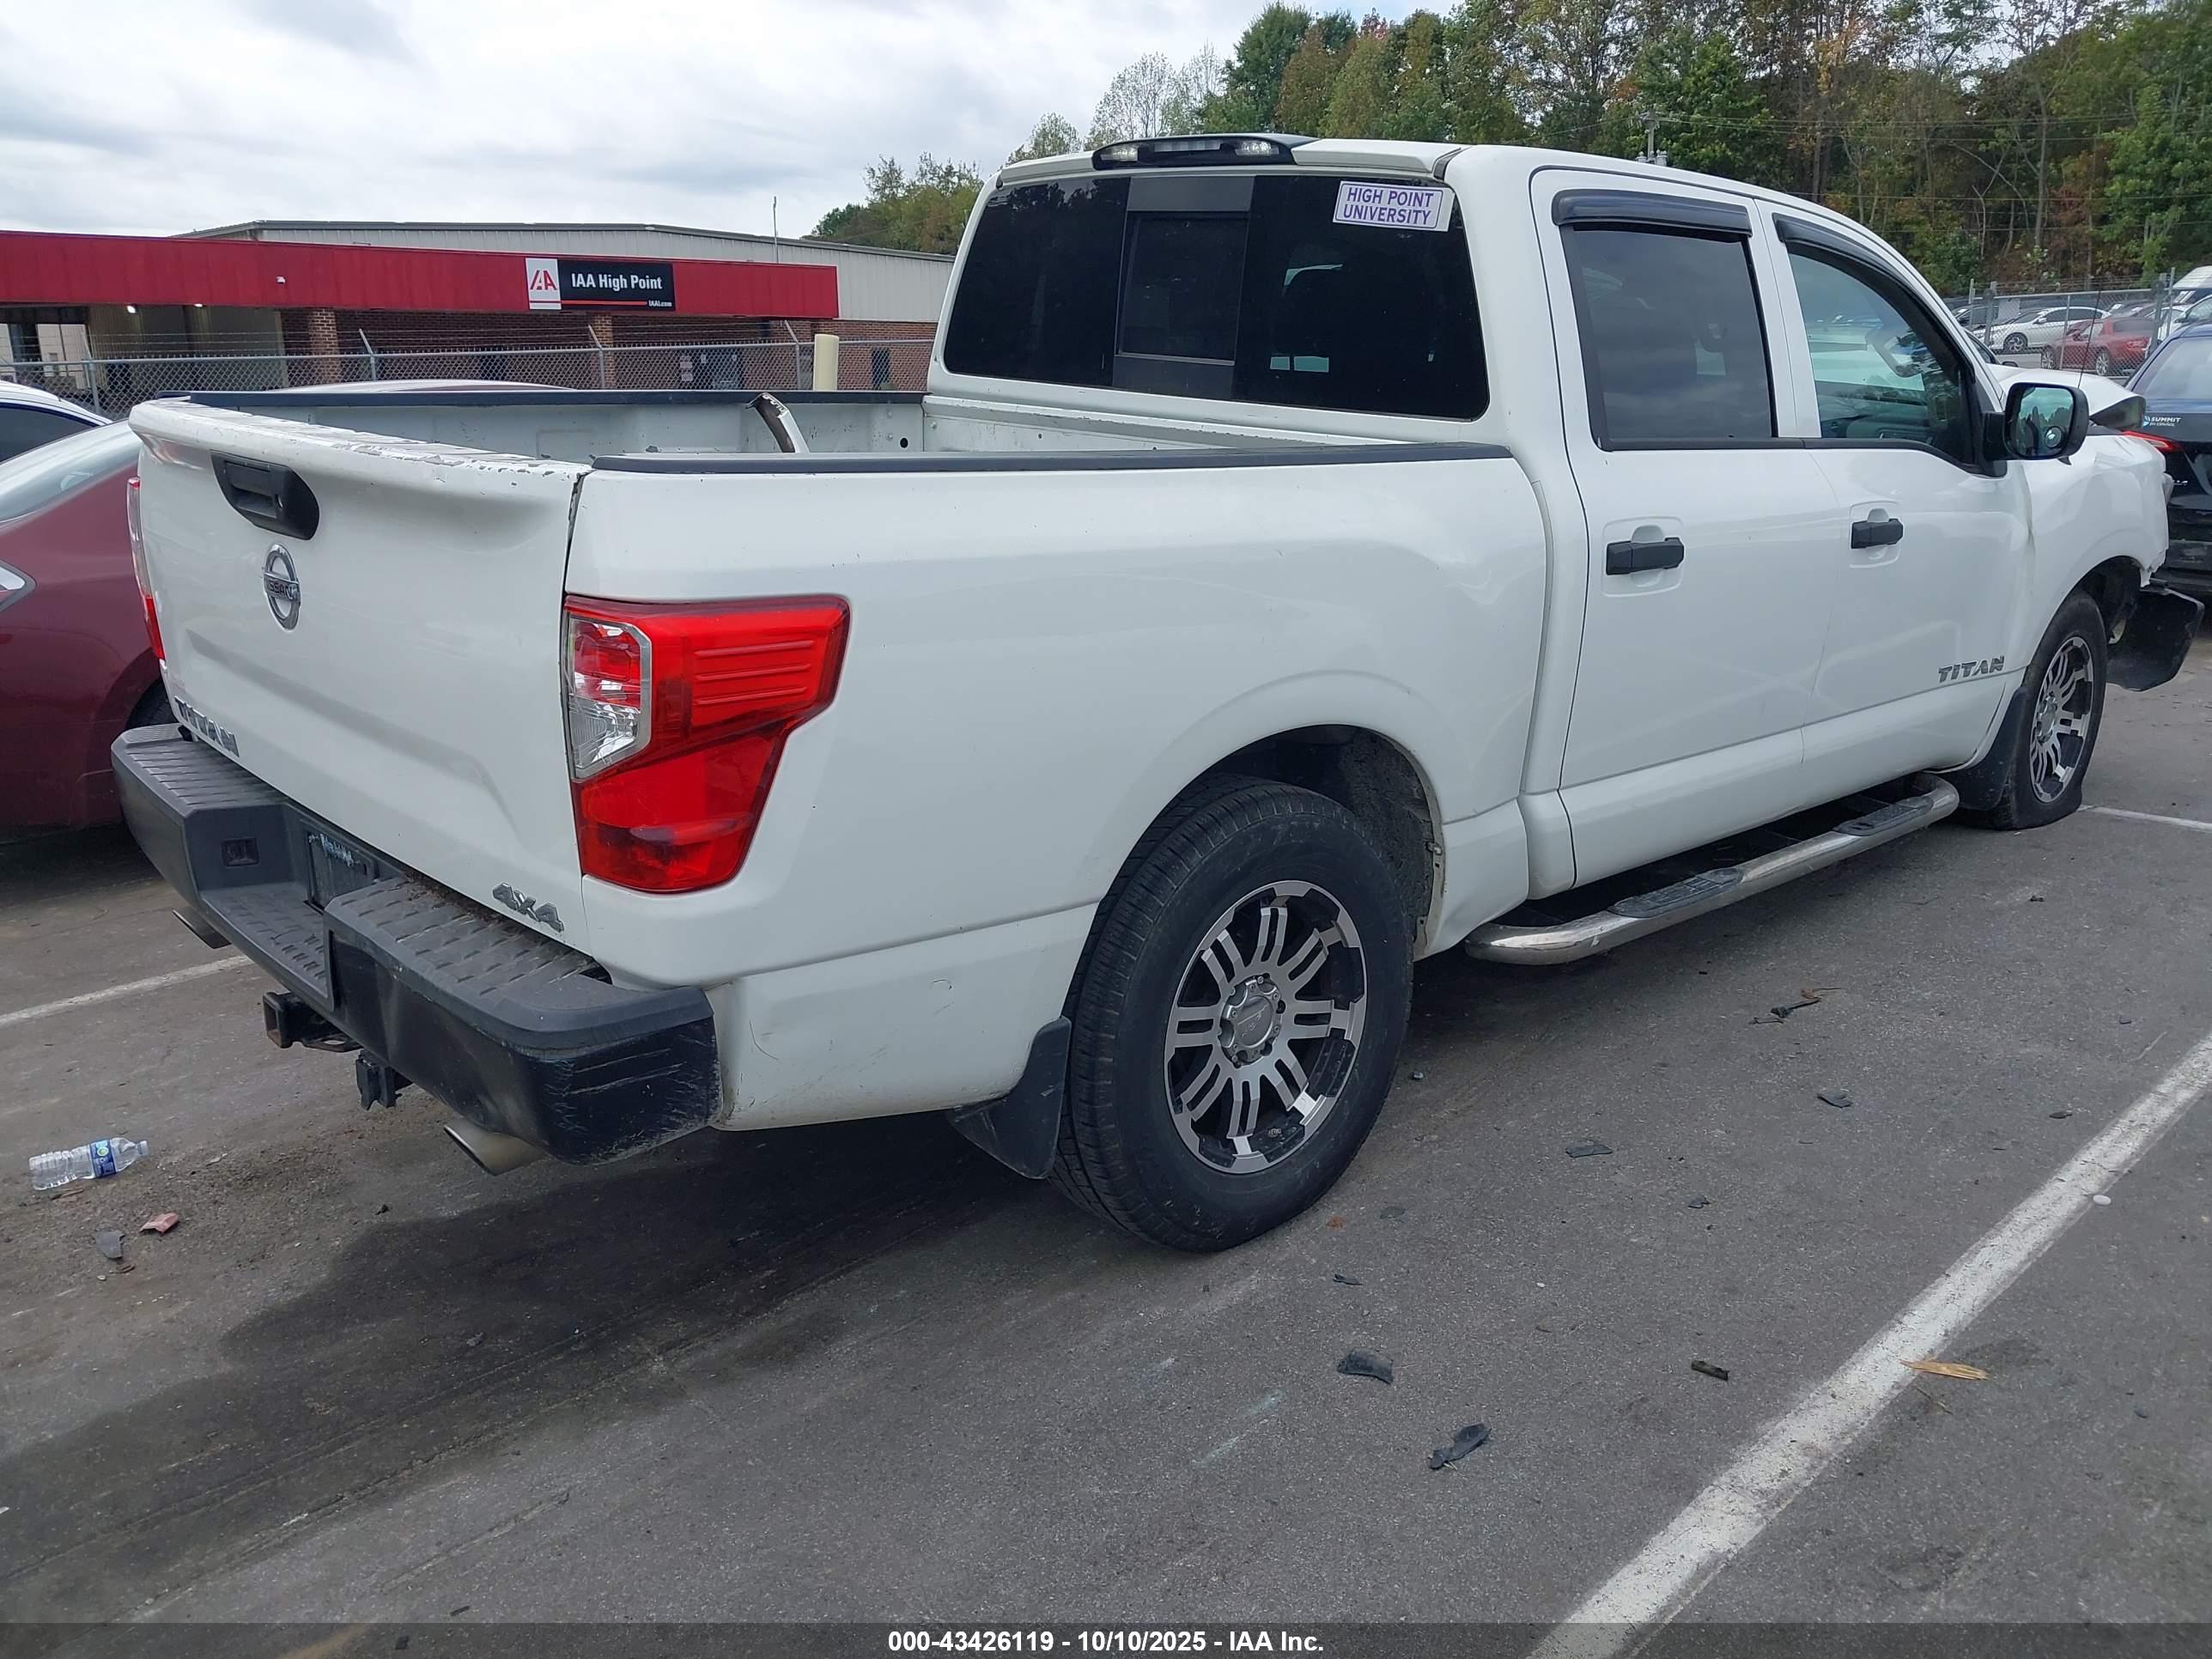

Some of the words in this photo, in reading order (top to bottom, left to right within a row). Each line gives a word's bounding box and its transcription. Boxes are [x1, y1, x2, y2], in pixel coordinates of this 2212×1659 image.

[1346, 186, 1383, 204] HIGH
[1387, 190, 1433, 208] POINT
[1343, 204, 1431, 225] UNIVERSITY
[571, 273, 597, 288] IAA
[599, 274, 628, 292] High
[630, 275, 663, 289] Point
[1938, 655, 2005, 684] TITAN
[173, 695, 240, 758] TITAN
